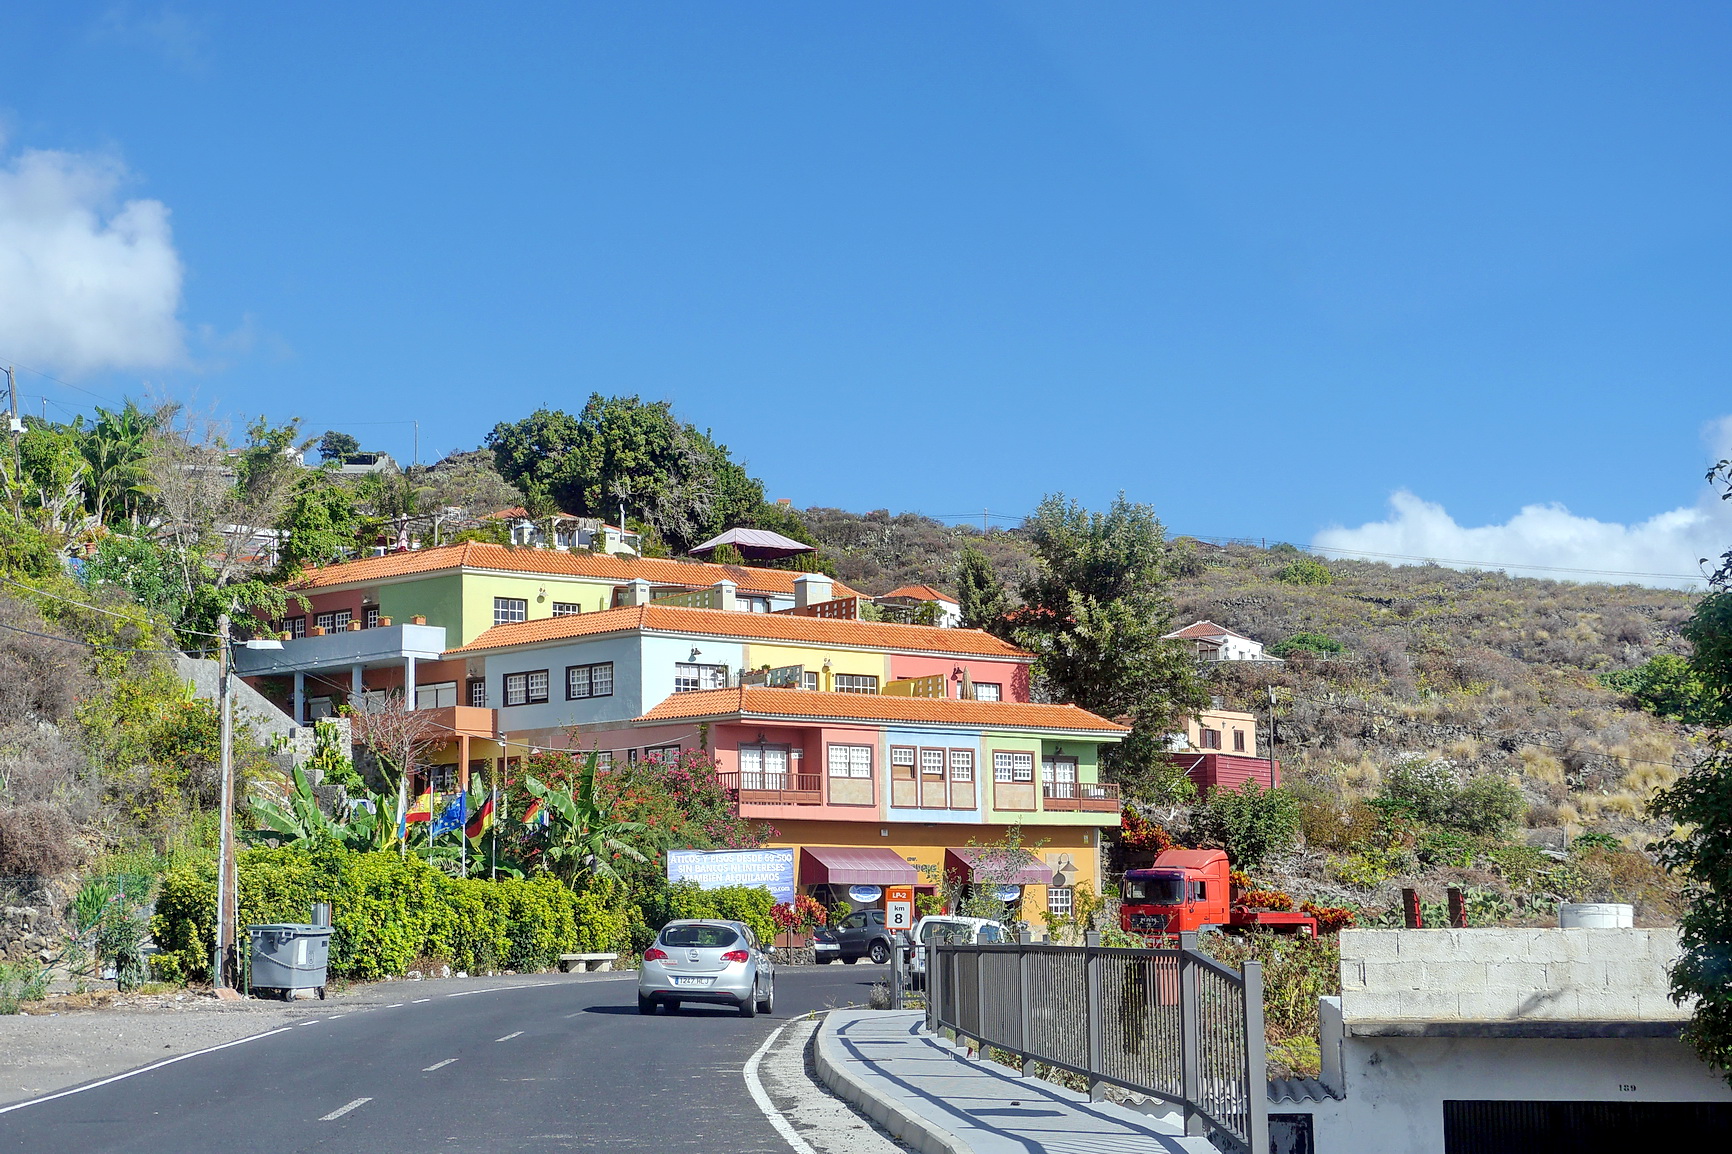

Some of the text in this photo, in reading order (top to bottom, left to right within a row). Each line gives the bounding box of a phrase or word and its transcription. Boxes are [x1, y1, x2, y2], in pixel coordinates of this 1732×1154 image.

[702, 855, 708, 863] Y
[711, 854, 733, 863] PISOS
[737, 854, 762, 862] DESDE
[678, 863, 785, 873] SIN BANCOS NI INTERESES
[725, 873, 779, 882] ALQUILAMOS
[894, 914, 902, 924] 8
